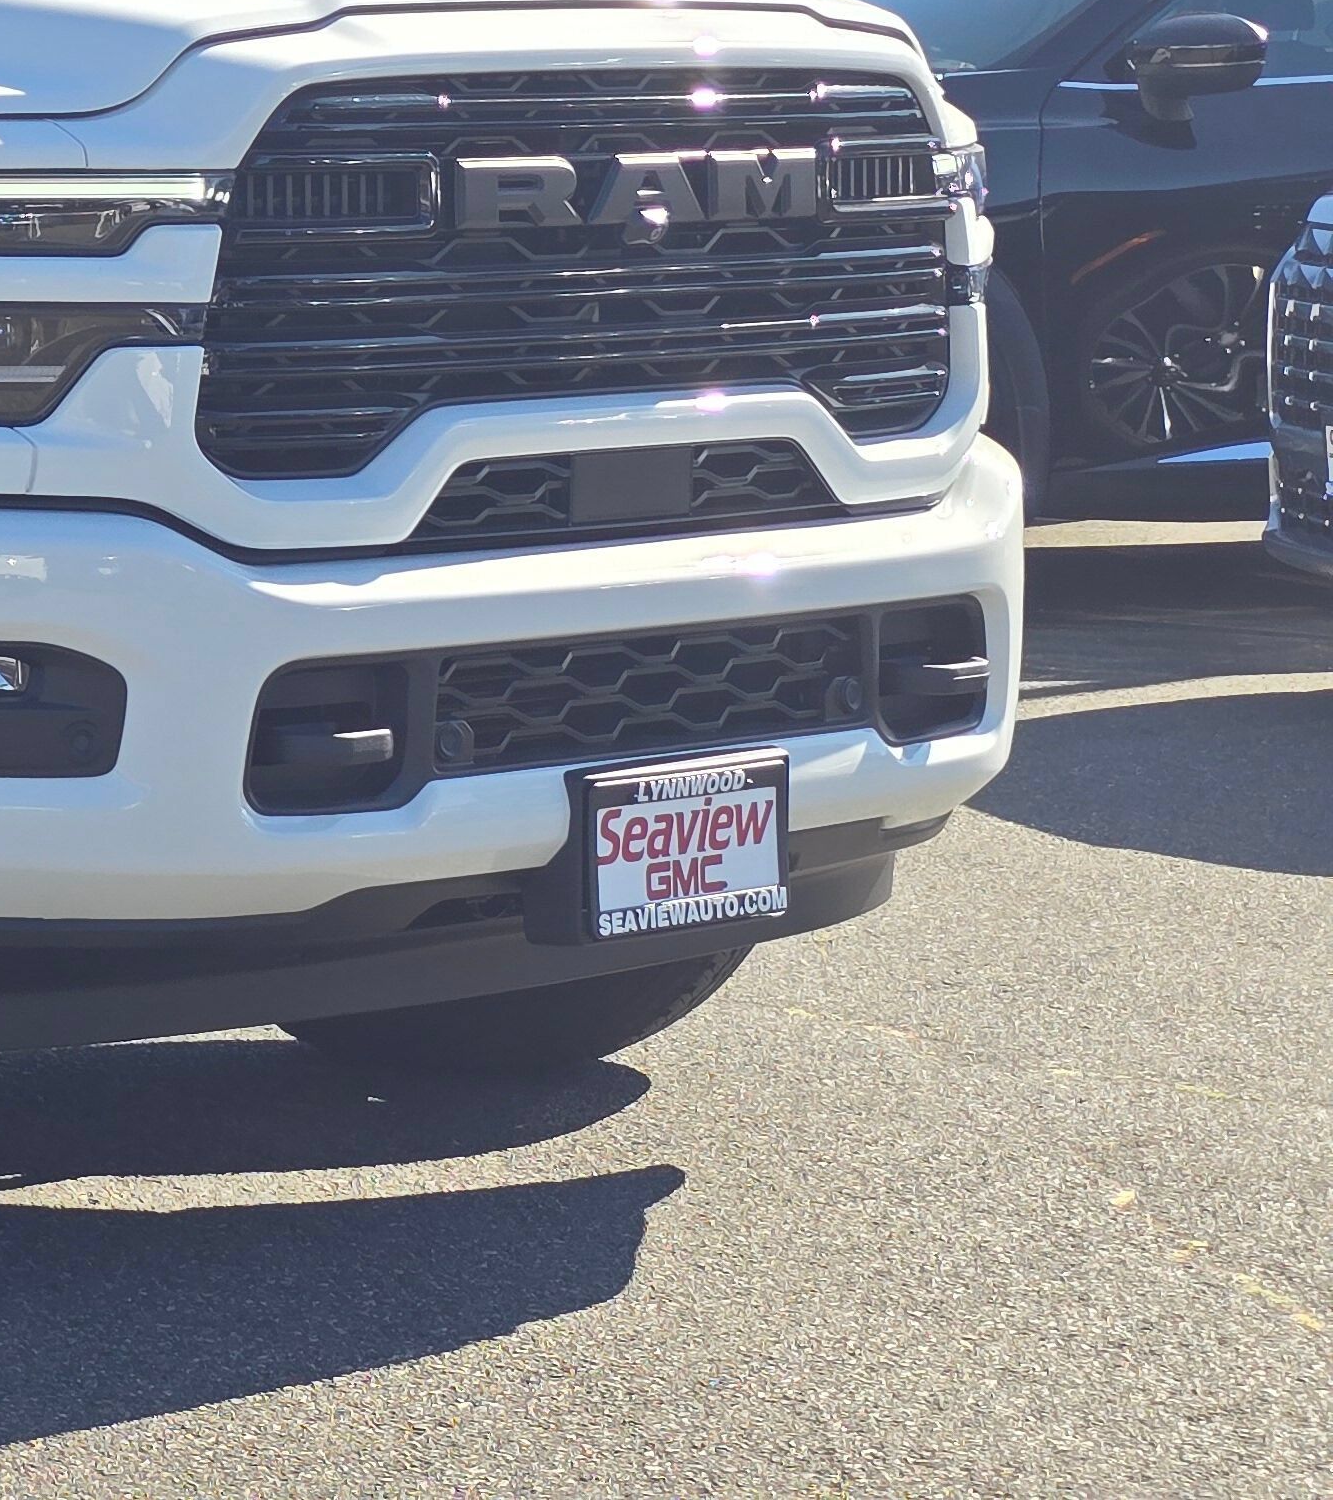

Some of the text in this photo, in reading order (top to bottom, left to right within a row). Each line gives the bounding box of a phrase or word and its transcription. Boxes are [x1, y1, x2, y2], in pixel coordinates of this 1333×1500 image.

[454, 145, 818, 231] RAM
[637, 769, 747, 803] LYNNWOOD
[597, 797, 774, 867] Seaview
[645, 853, 728, 902] GMC
[598, 886, 788, 938] SEAVIEWAUTO.COM
